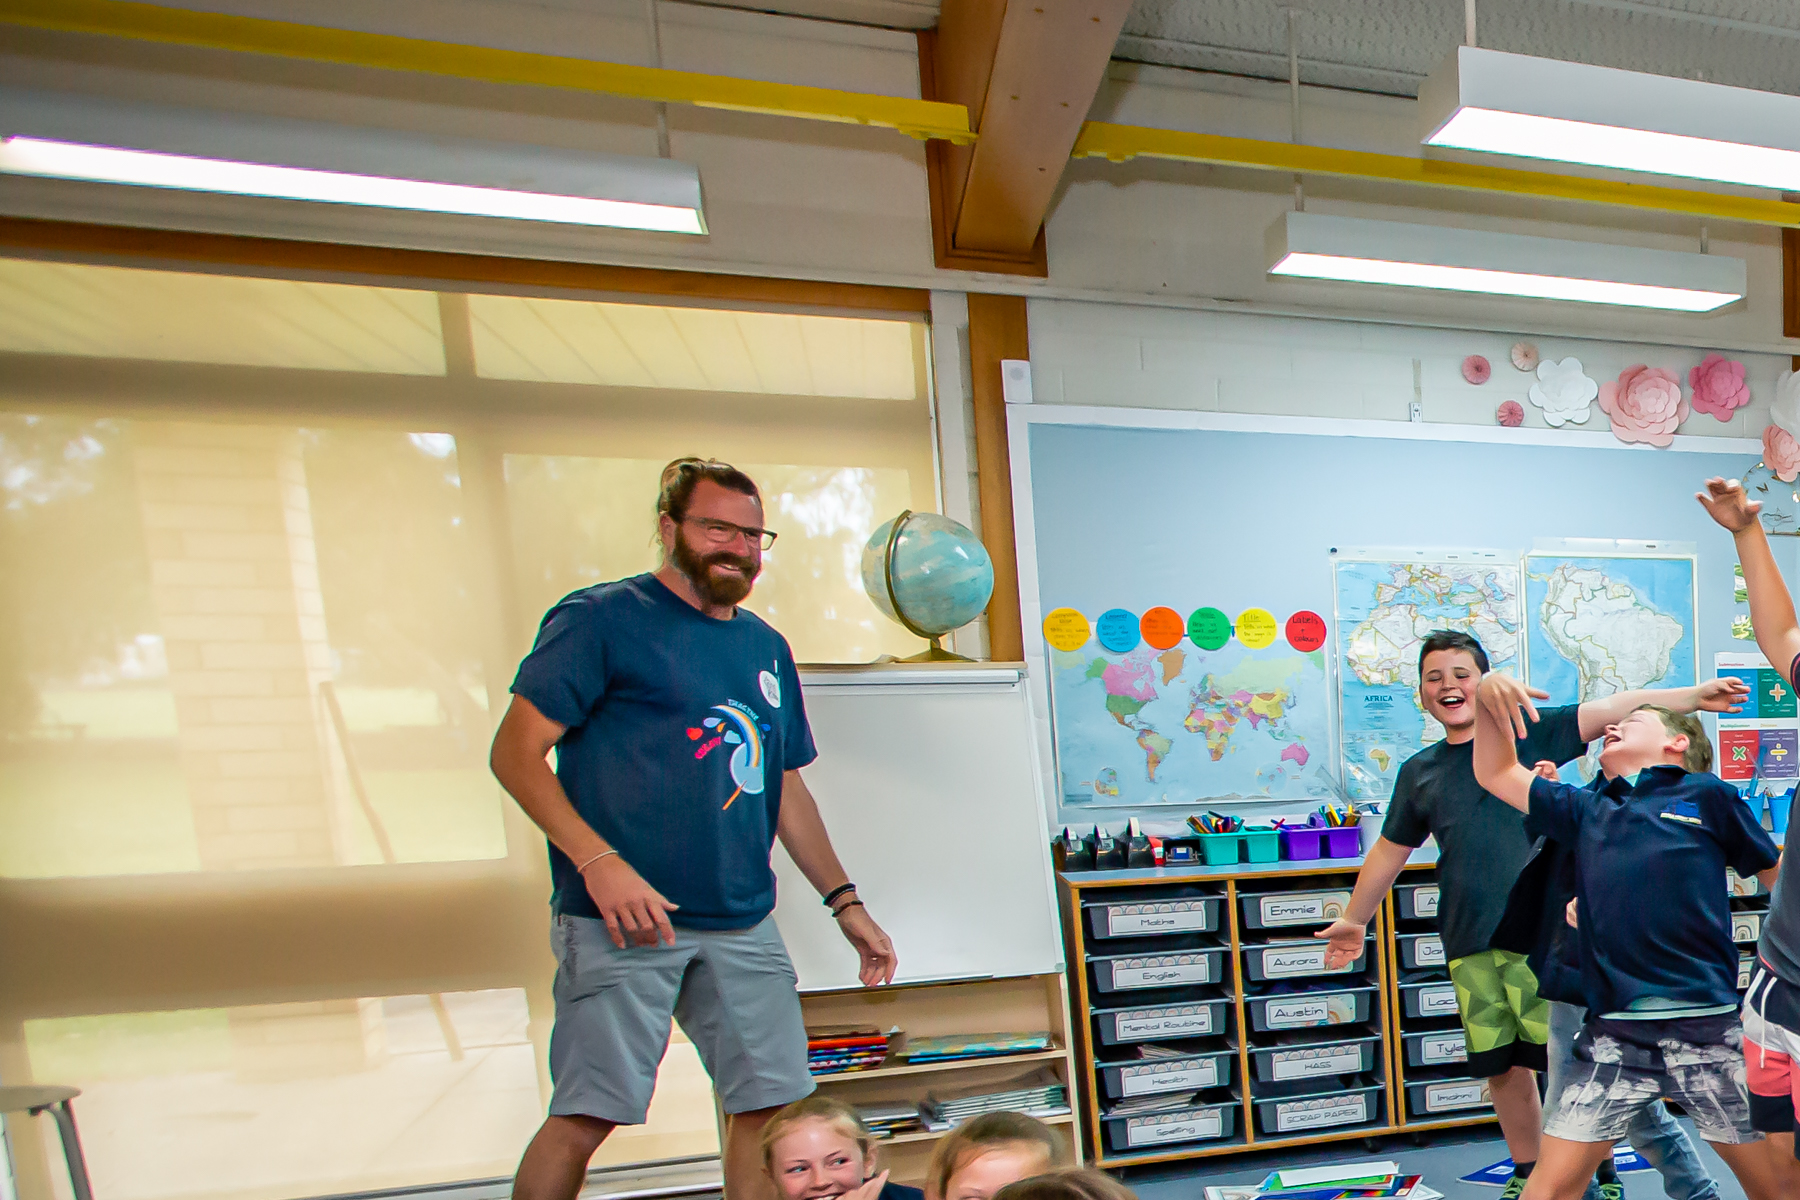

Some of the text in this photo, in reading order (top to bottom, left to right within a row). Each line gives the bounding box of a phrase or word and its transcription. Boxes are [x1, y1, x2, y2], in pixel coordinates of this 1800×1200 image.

[1242, 613, 1259, 621] Title
[1292, 615, 1319, 624] Labels
[1270, 905, 1316, 916] Emmie
[1140, 918, 1175, 926] Maths
[1273, 958, 1318, 967] Aurora
[1142, 971, 1181, 981] English
[1274, 1007, 1323, 1018] Austin
[1123, 1018, 1206, 1033] Mental Routine
[1304, 1061, 1332, 1071] HASS
[1152, 1076, 1188, 1086] Health
[1286, 1108, 1358, 1124] SCRAP PAPER
[1156, 1127, 1196, 1137] Spelling
